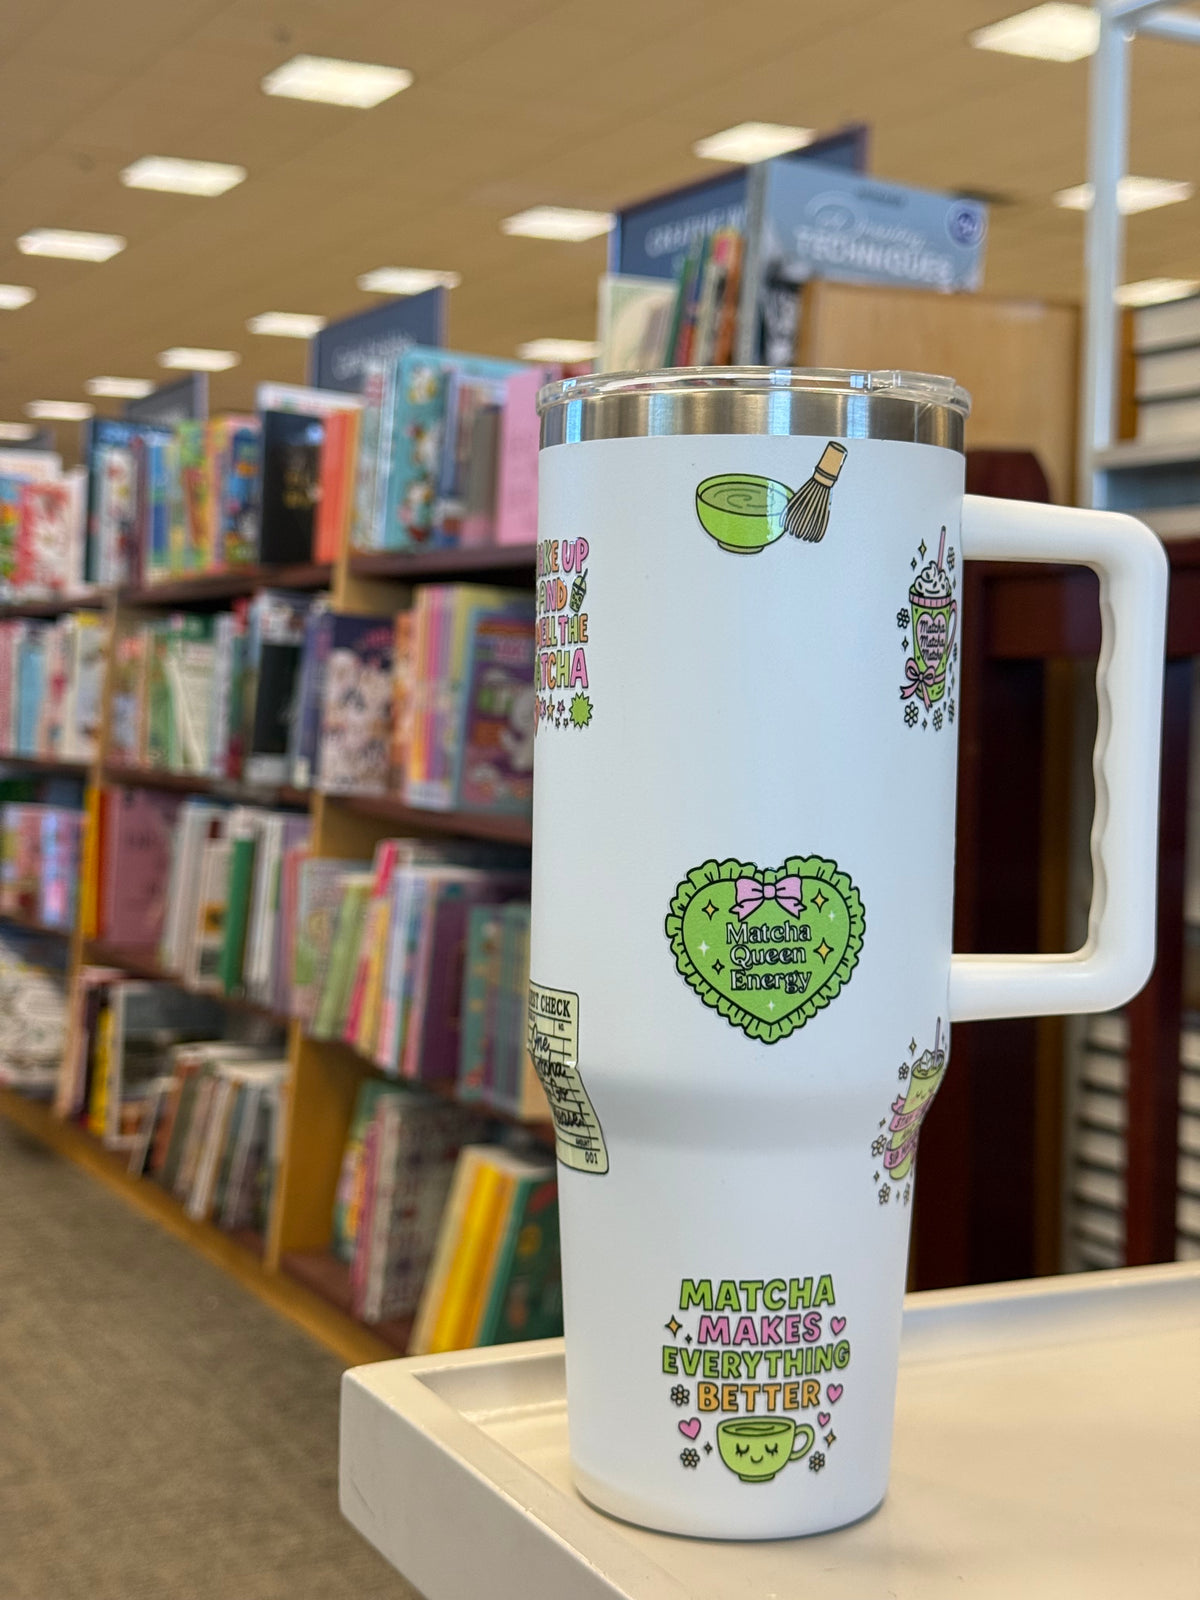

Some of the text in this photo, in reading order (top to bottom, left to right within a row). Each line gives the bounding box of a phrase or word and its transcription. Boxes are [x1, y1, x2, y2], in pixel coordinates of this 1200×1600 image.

[562, 537, 589, 573] UP
[558, 613, 588, 645] THE
[919, 619, 945, 632] Matcha
[919, 634, 946, 647] Matcha
[726, 921, 812, 944] Matcha
[730, 945, 806, 970] Queen
[731, 969, 812, 994] Energy
[541, 995, 571, 1018] CHECK
[585, 1151, 598, 1164] 001
[679, 1274, 836, 1312] MATCHA
[697, 1311, 822, 1346] MAKES
[662, 1339, 850, 1379] EVERYTHING
[697, 1379, 821, 1412] BETTER
